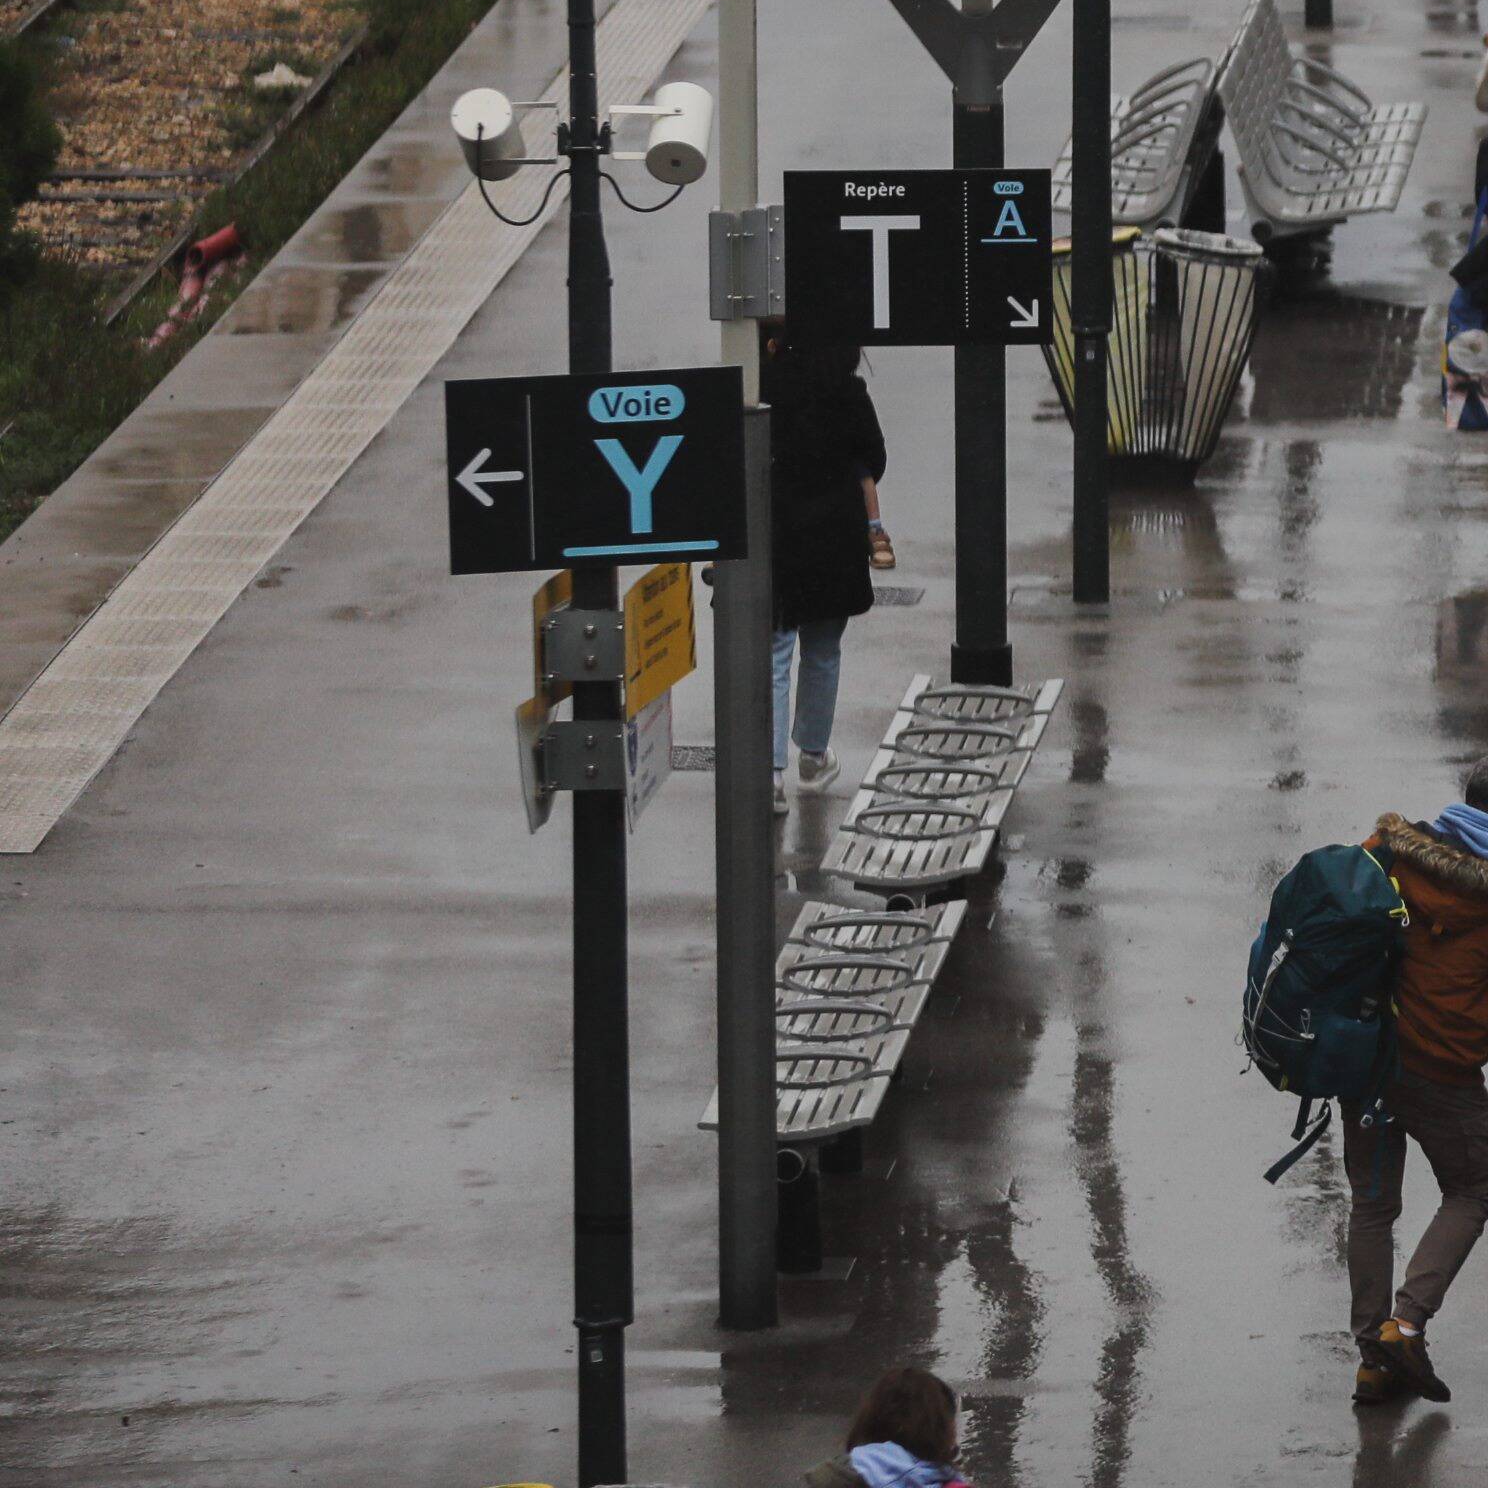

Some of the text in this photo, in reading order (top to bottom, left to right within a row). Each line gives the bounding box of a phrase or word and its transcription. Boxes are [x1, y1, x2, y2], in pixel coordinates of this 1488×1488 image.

[844, 181, 906, 200] Repère
[997, 183, 1020, 193] Voie
[993, 200, 1027, 236] A
[840, 215, 921, 329] T
[600, 390, 672, 418] Voie
[593, 435, 685, 534] Y
